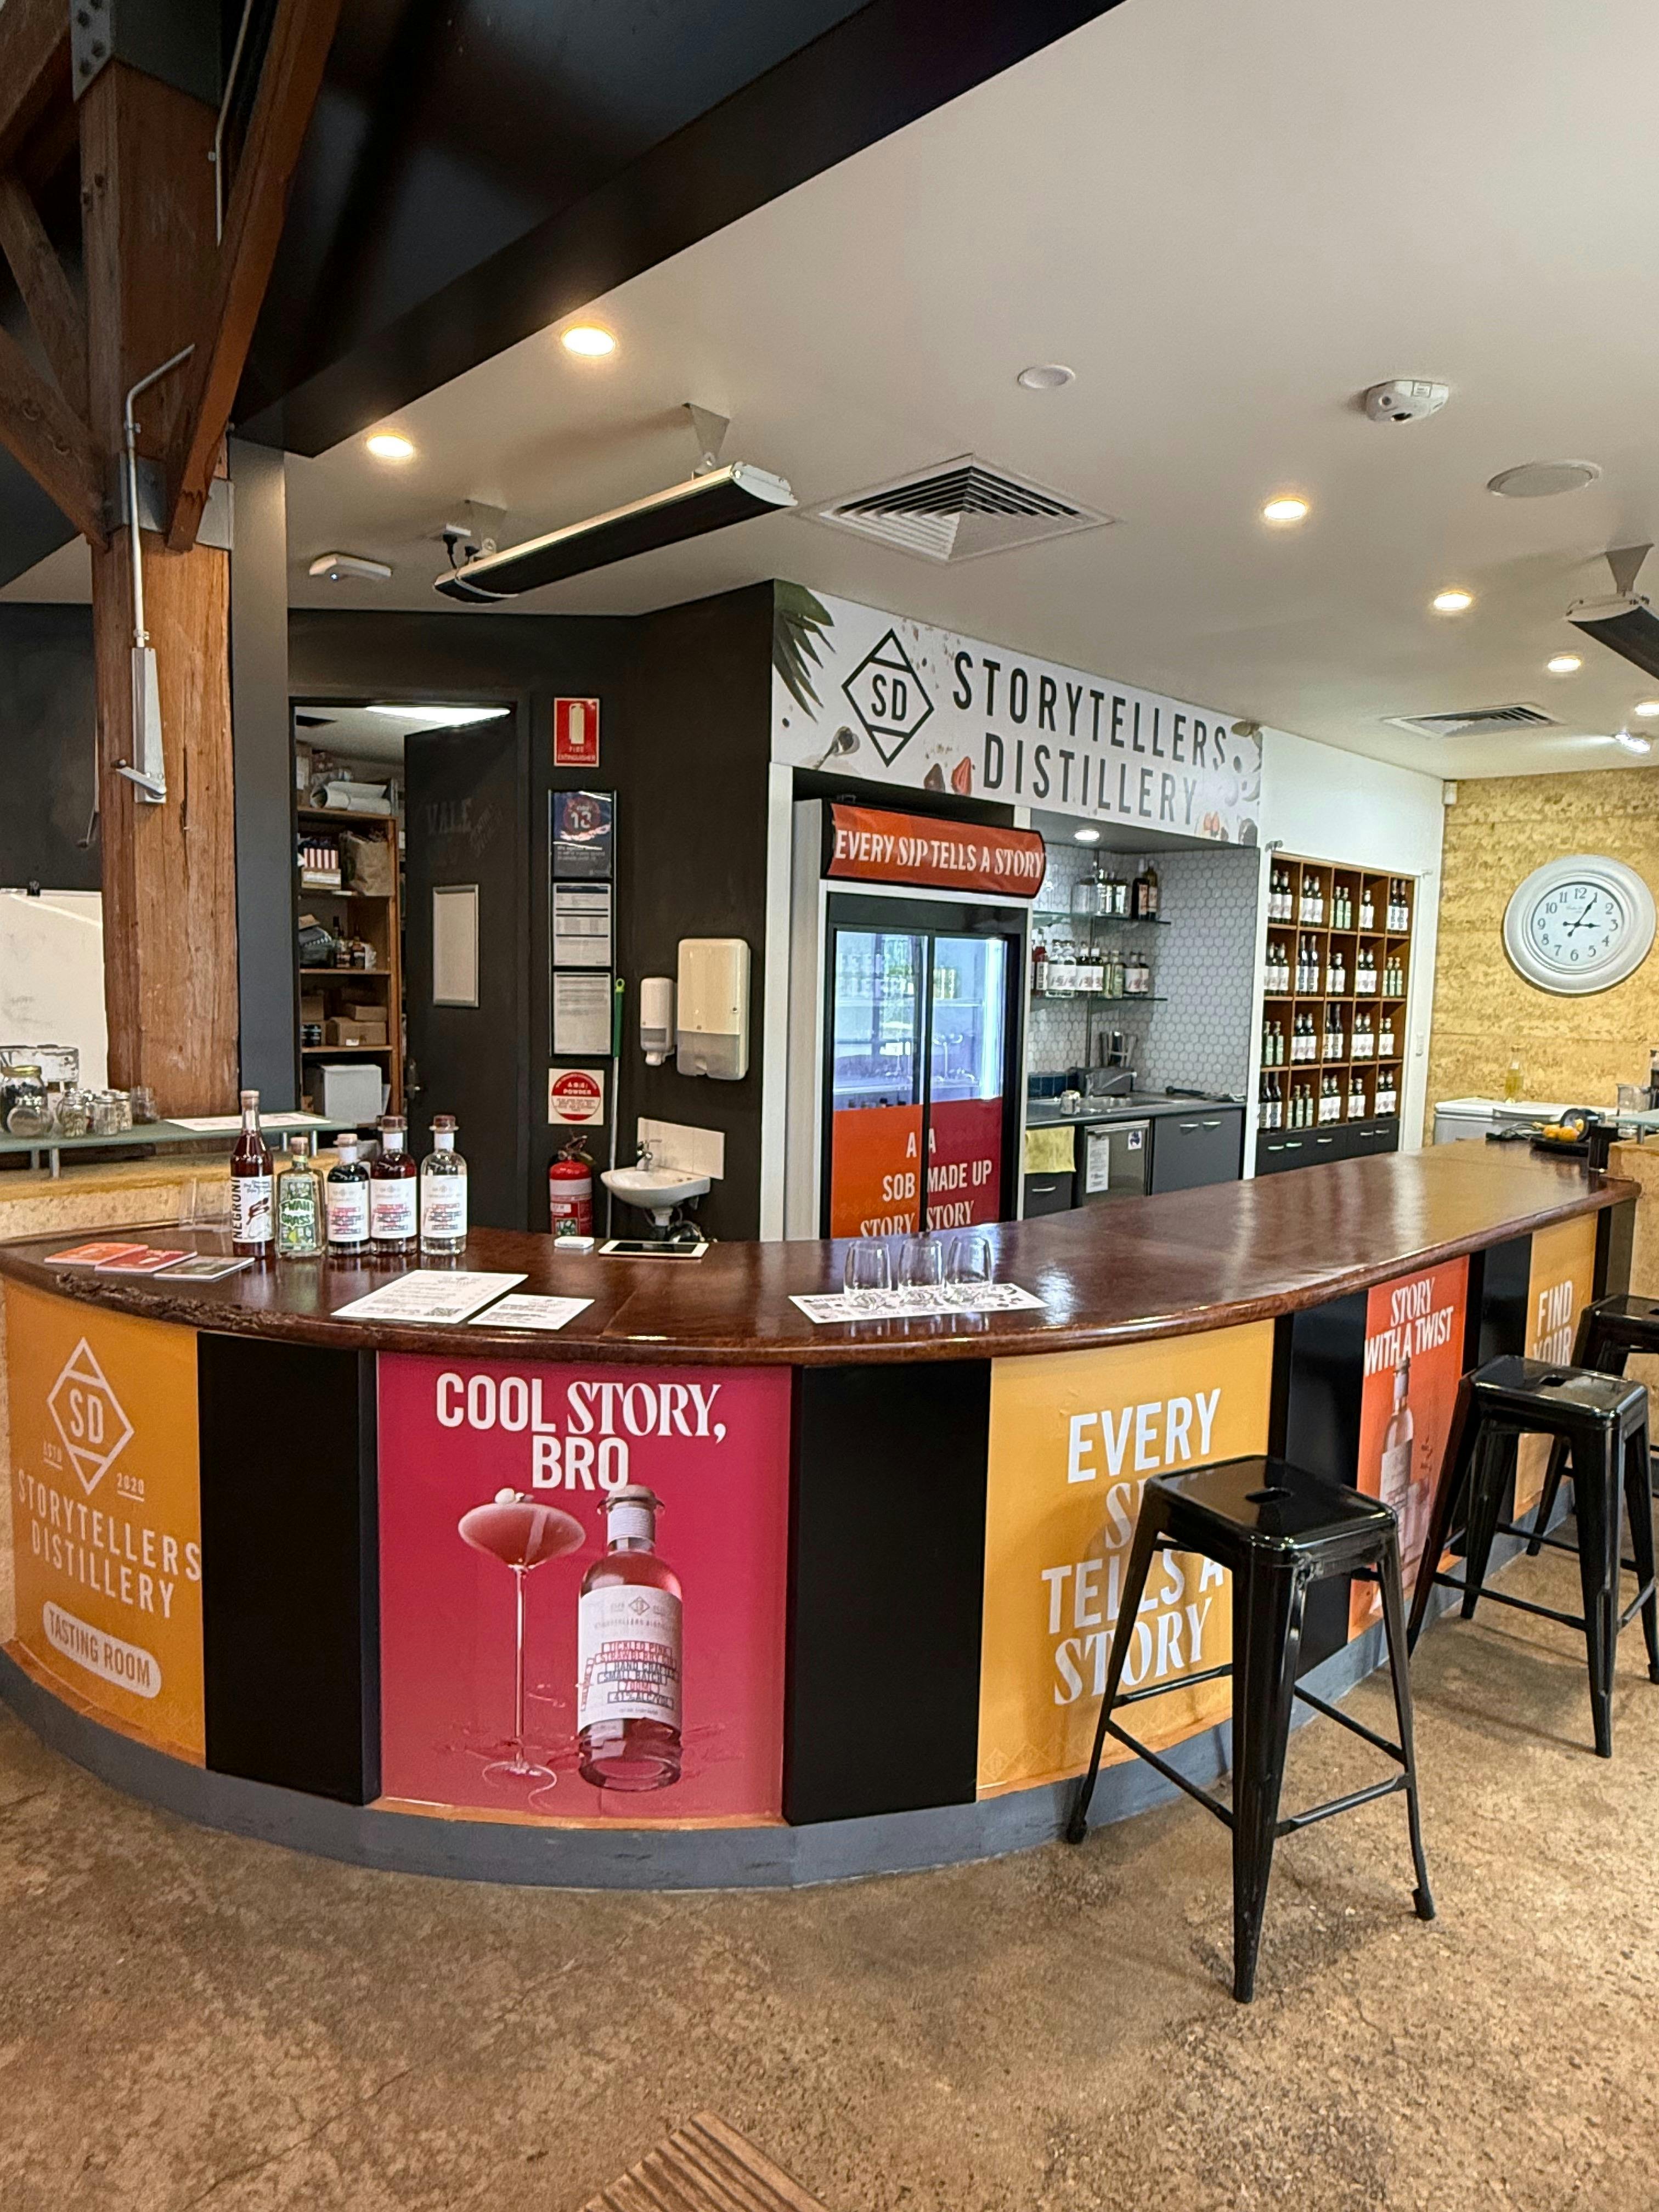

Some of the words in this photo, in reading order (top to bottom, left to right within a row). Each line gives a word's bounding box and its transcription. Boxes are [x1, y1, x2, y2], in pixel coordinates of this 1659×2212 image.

[871, 673, 907, 721] SD
[953, 651, 1227, 770] STORYTELLERS
[984, 732, 1198, 825] DISTILLERY
[835, 829, 895, 863] EVERY
[896, 836, 928, 867] SIP
[929, 840, 977, 871] TELLS
[979, 846, 990, 873] A
[994, 848, 1044, 878] STORY
[1545, 902, 1558, 913] 10
[1559, 891, 1568, 904] 11
[1574, 887, 1587, 900] 12
[1605, 902, 1614, 915] 2
[1537, 918, 1545, 930] 9
[1541, 934, 1549, 945] 8
[1609, 919, 1618, 931] 3
[1554, 945, 1562, 956] 7
[1570, 949, 1579, 961] 6
[1588, 945, 1596, 957] 5
[1601, 935, 1610, 947] 4
[906, 1132, 917, 1158] A
[928, 1128, 936, 1154] A
[882, 1172, 916, 1202] SOB
[927, 1163, 968, 1193] MADE
[972, 1159, 992, 1186] UP
[232, 1180, 242, 1239] NEGRONI
[860, 1212, 915, 1238] STORY
[926, 1200, 974, 1232] STORY
[1391, 1276, 1435, 1327] STORY
[1537, 1280, 1573, 1337] FIND
[1364, 1326, 1401, 1377] WITH
[1401, 1322, 1412, 1361] A
[1415, 1306, 1454, 1355] TWIST
[69, 1388, 104, 1444] SD
[436, 1372, 556, 1434] COOL
[567, 1381, 727, 1444] STORY,
[1068, 1388, 1222, 1483] EVERY
[532, 1434, 630, 1491] BRO
[116, 1472, 145, 1494] 2020
[18, 1469, 201, 1581] STORYTELLERS
[32, 1518, 174, 1618] DISTILLERY
[49, 1606, 99, 1662] TASTING
[104, 1642, 150, 1688] ROOM
[1054, 1597, 1212, 1705] STORY
